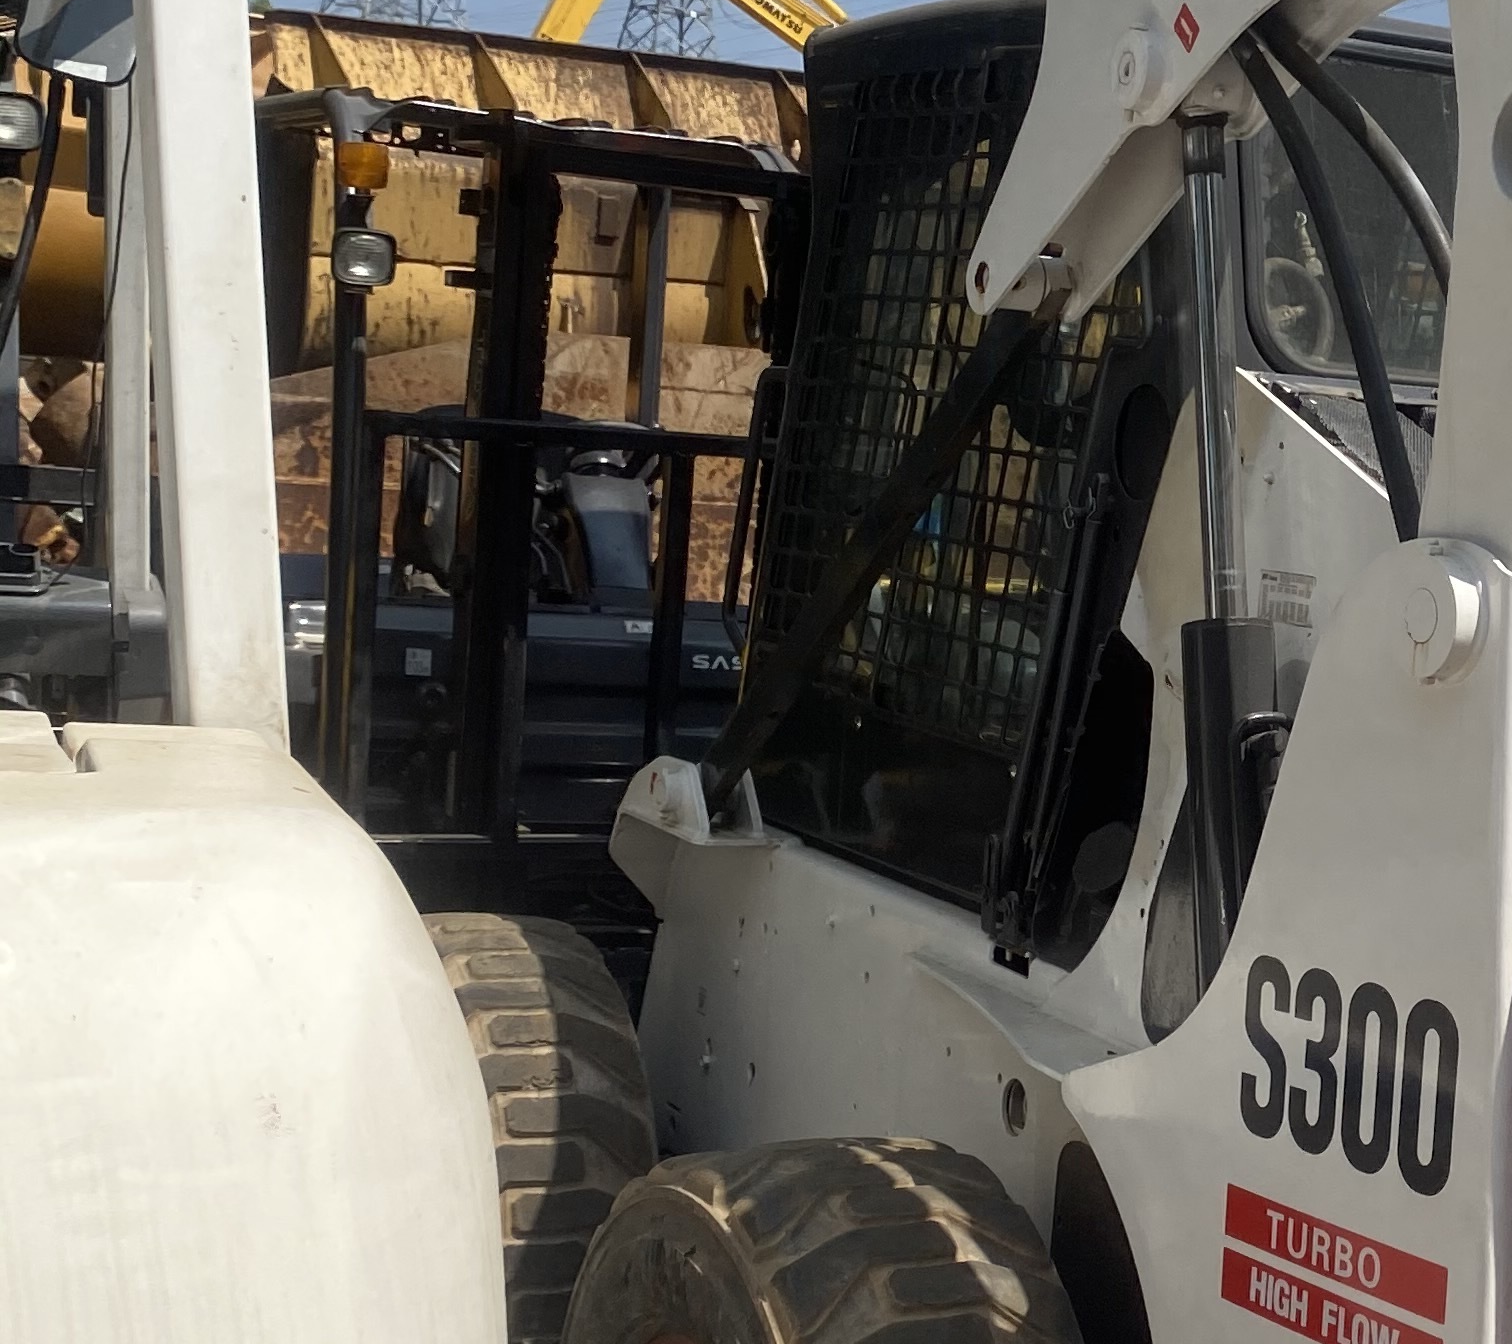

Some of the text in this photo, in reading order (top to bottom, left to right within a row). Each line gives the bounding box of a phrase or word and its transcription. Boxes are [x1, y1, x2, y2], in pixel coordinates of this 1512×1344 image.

[1240, 954, 1460, 1197] S300
[1265, 1208, 1382, 1289] TURBO
[1248, 1265, 1309, 1329] HIGH
